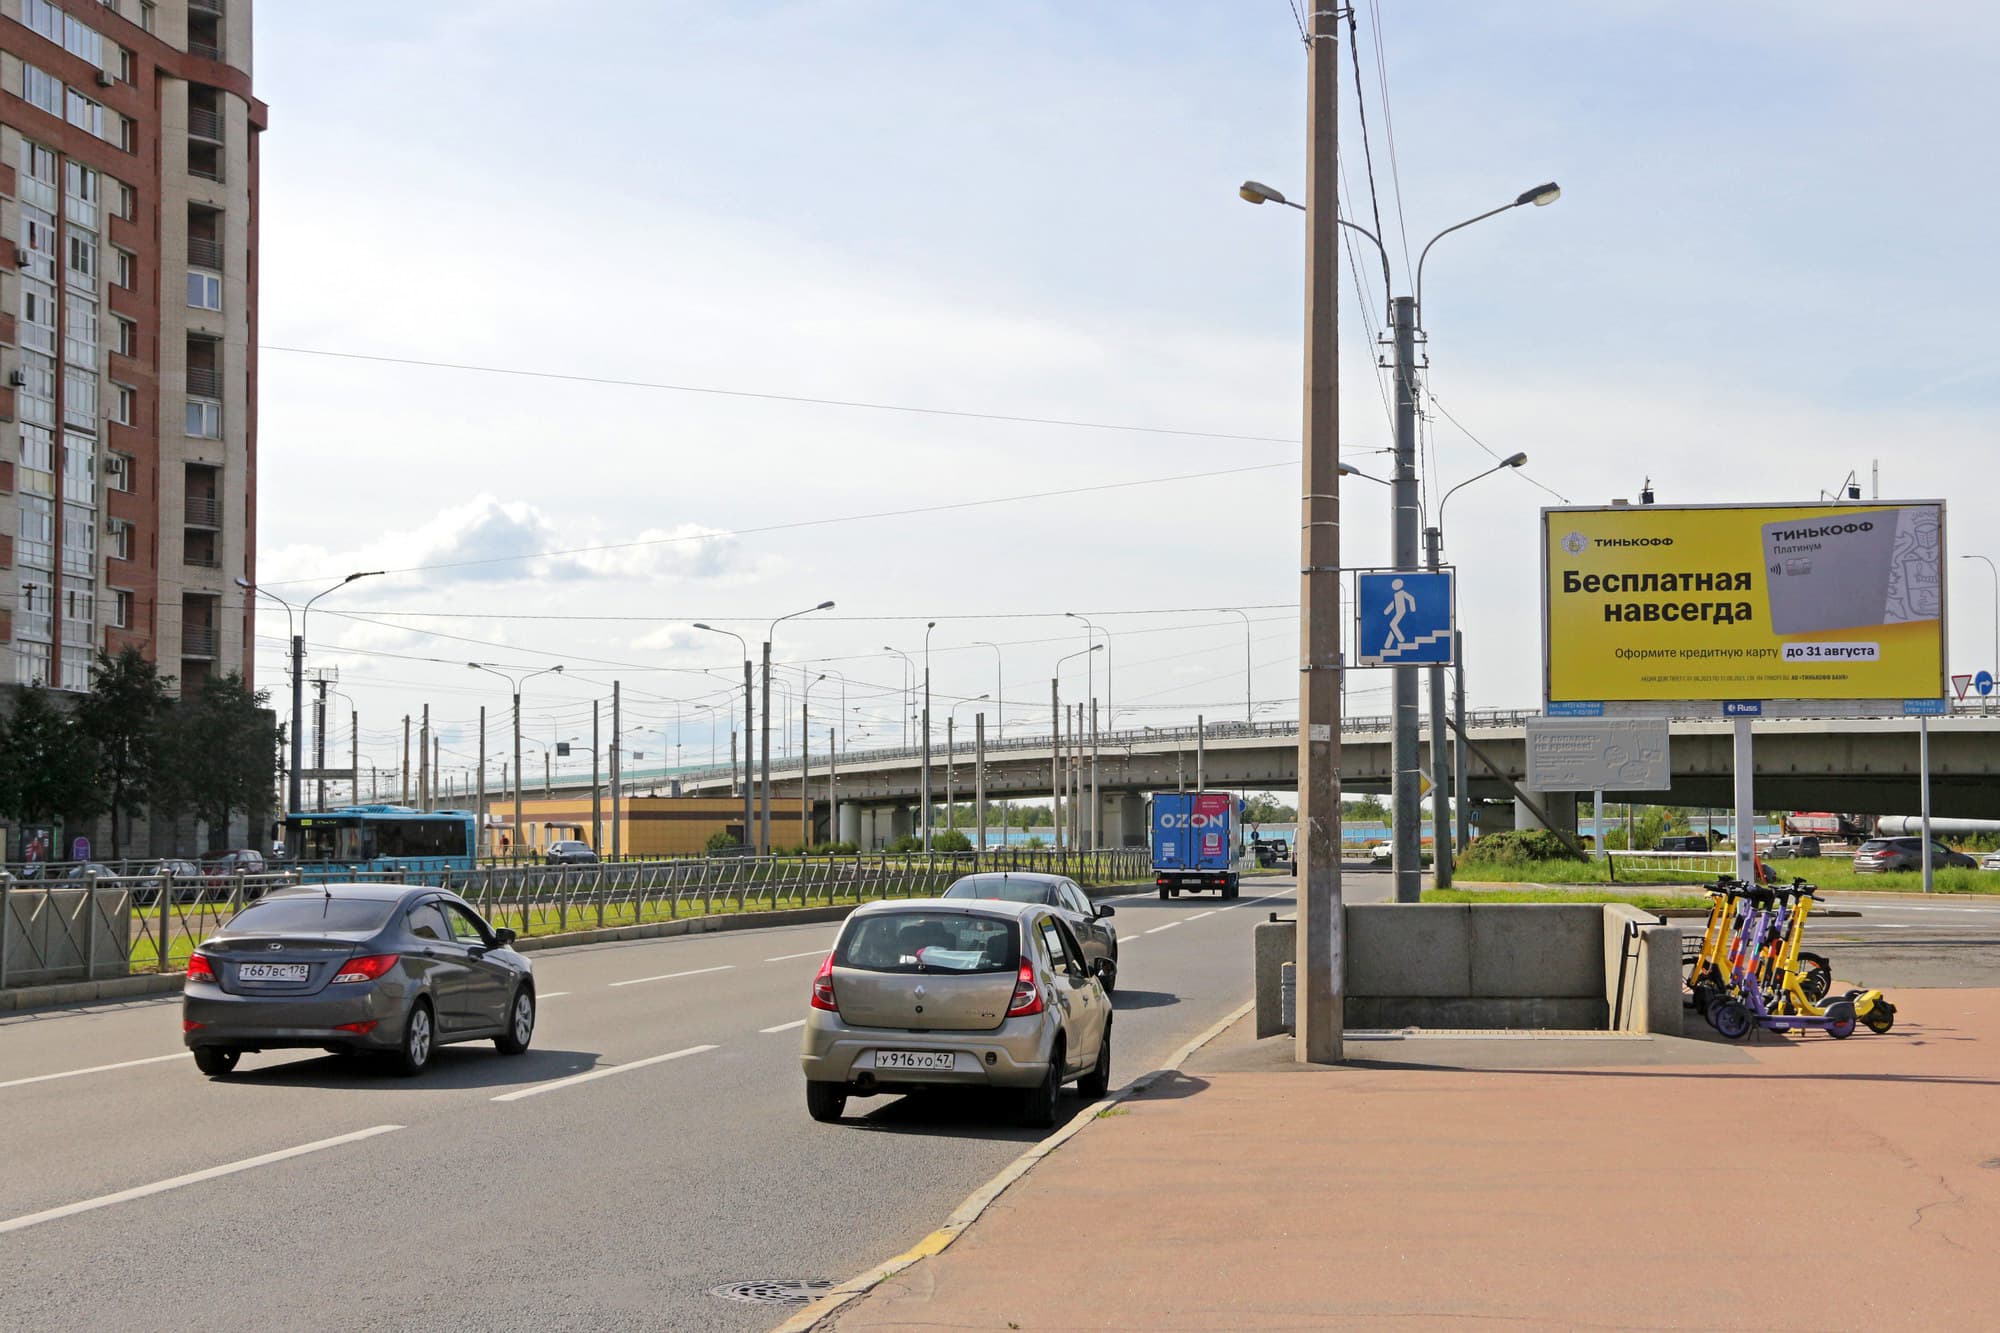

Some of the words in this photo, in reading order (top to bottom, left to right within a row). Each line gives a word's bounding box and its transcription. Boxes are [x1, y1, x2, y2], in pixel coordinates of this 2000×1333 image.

[1771, 521, 1874, 542] ТИНЬКОФФ
[1594, 537, 1674, 547] ТИНЬКОФФ
[1773, 542, 1822, 555] Платинум
[1563, 570, 1752, 593] Бесплатная
[1604, 602, 1752, 625] навсегда
[1615, 648, 1677, 660] Оформите
[1679, 648, 1744, 660] кредитную
[1746, 648, 1778, 659] карту
[1786, 646, 1804, 658] до
[1806, 646, 1821, 657] 31
[1824, 646, 1875, 658] августа
[1737, 704, 1758, 712] Russ
[1160, 813, 1224, 829] OZON
[244, 965, 287, 977] Т667ВС
[289, 965, 305, 975] 178
[881, 1053, 933, 1067] У916УО
[936, 1054, 950, 1065] 47
